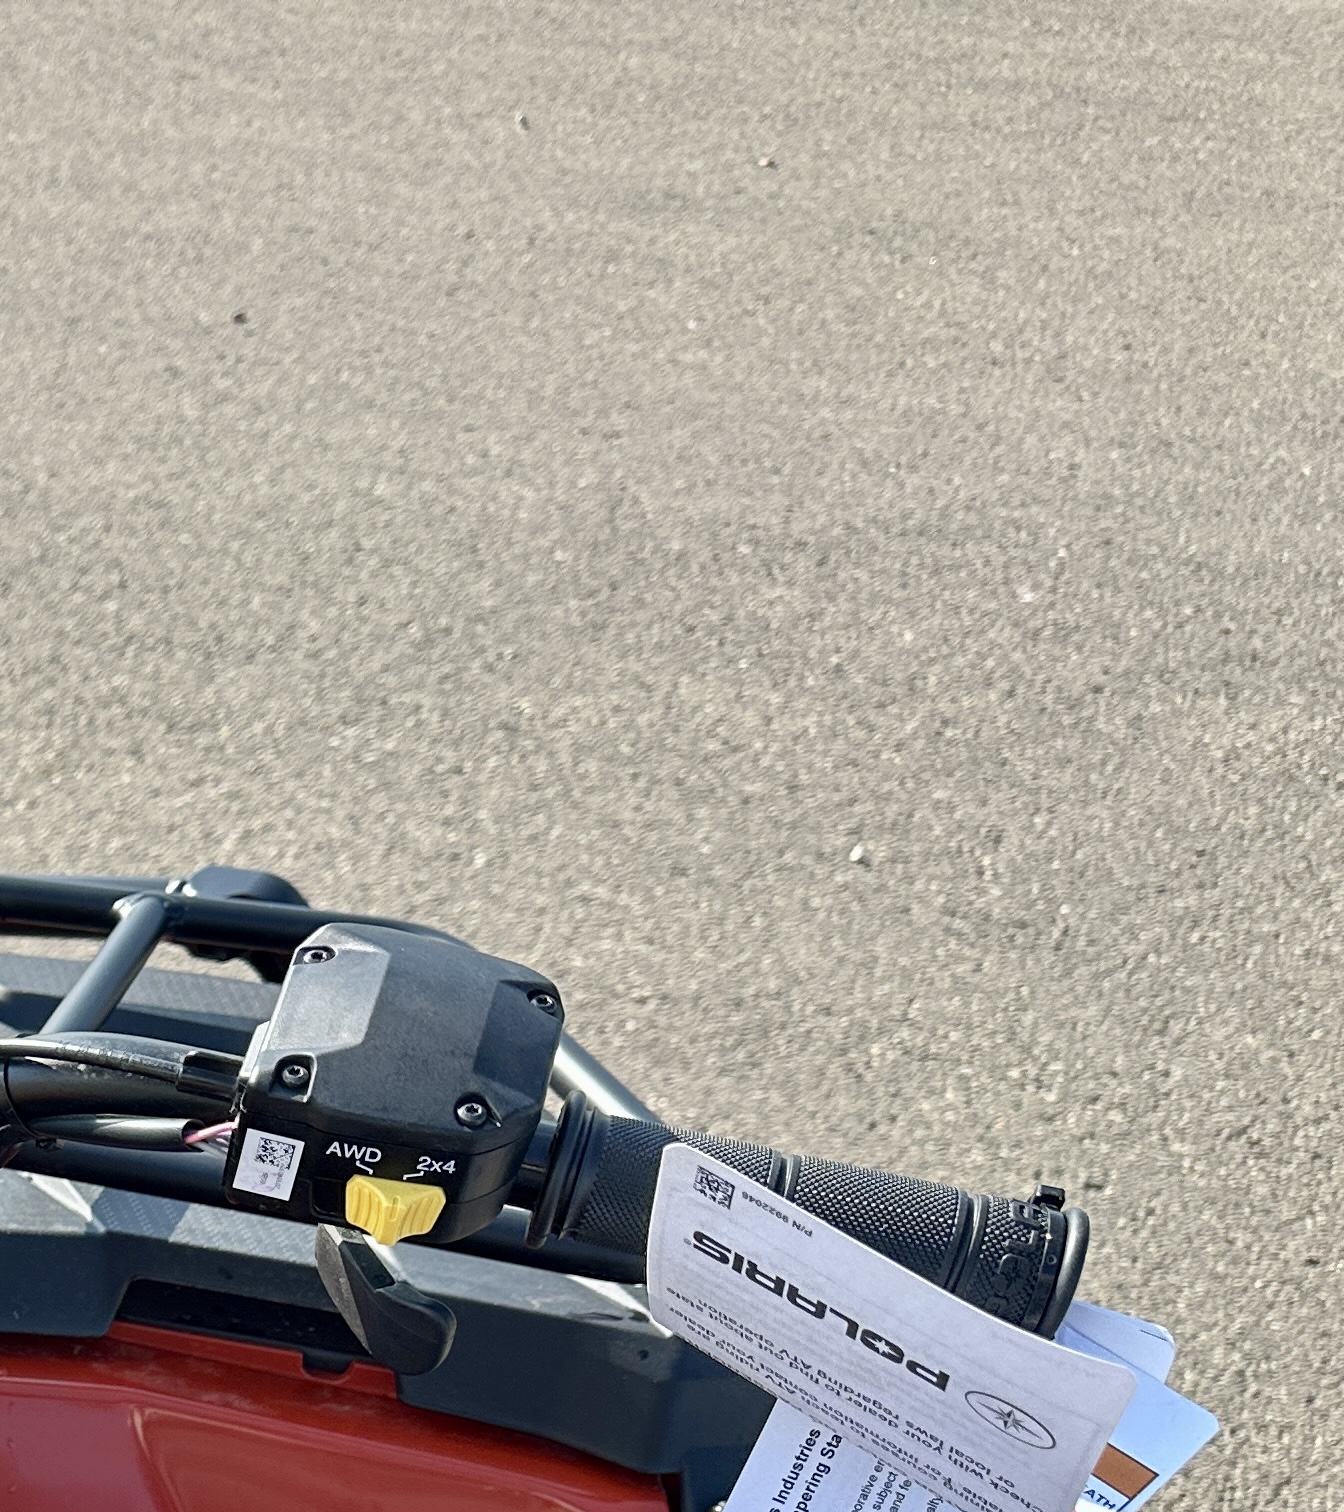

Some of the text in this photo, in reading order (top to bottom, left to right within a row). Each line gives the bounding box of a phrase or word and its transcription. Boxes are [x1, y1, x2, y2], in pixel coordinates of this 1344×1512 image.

[325, 1141, 382, 1163] AWD
[416, 1156, 456, 1174] 2x4
[792, 1220, 813, 1237] P/N
[693, 1232, 948, 1389] POLARIS
[772, 1429, 821, 1505] Industries
[872, 1471, 899, 1511] subject
[1083, 1485, 1116, 1511] ATH
